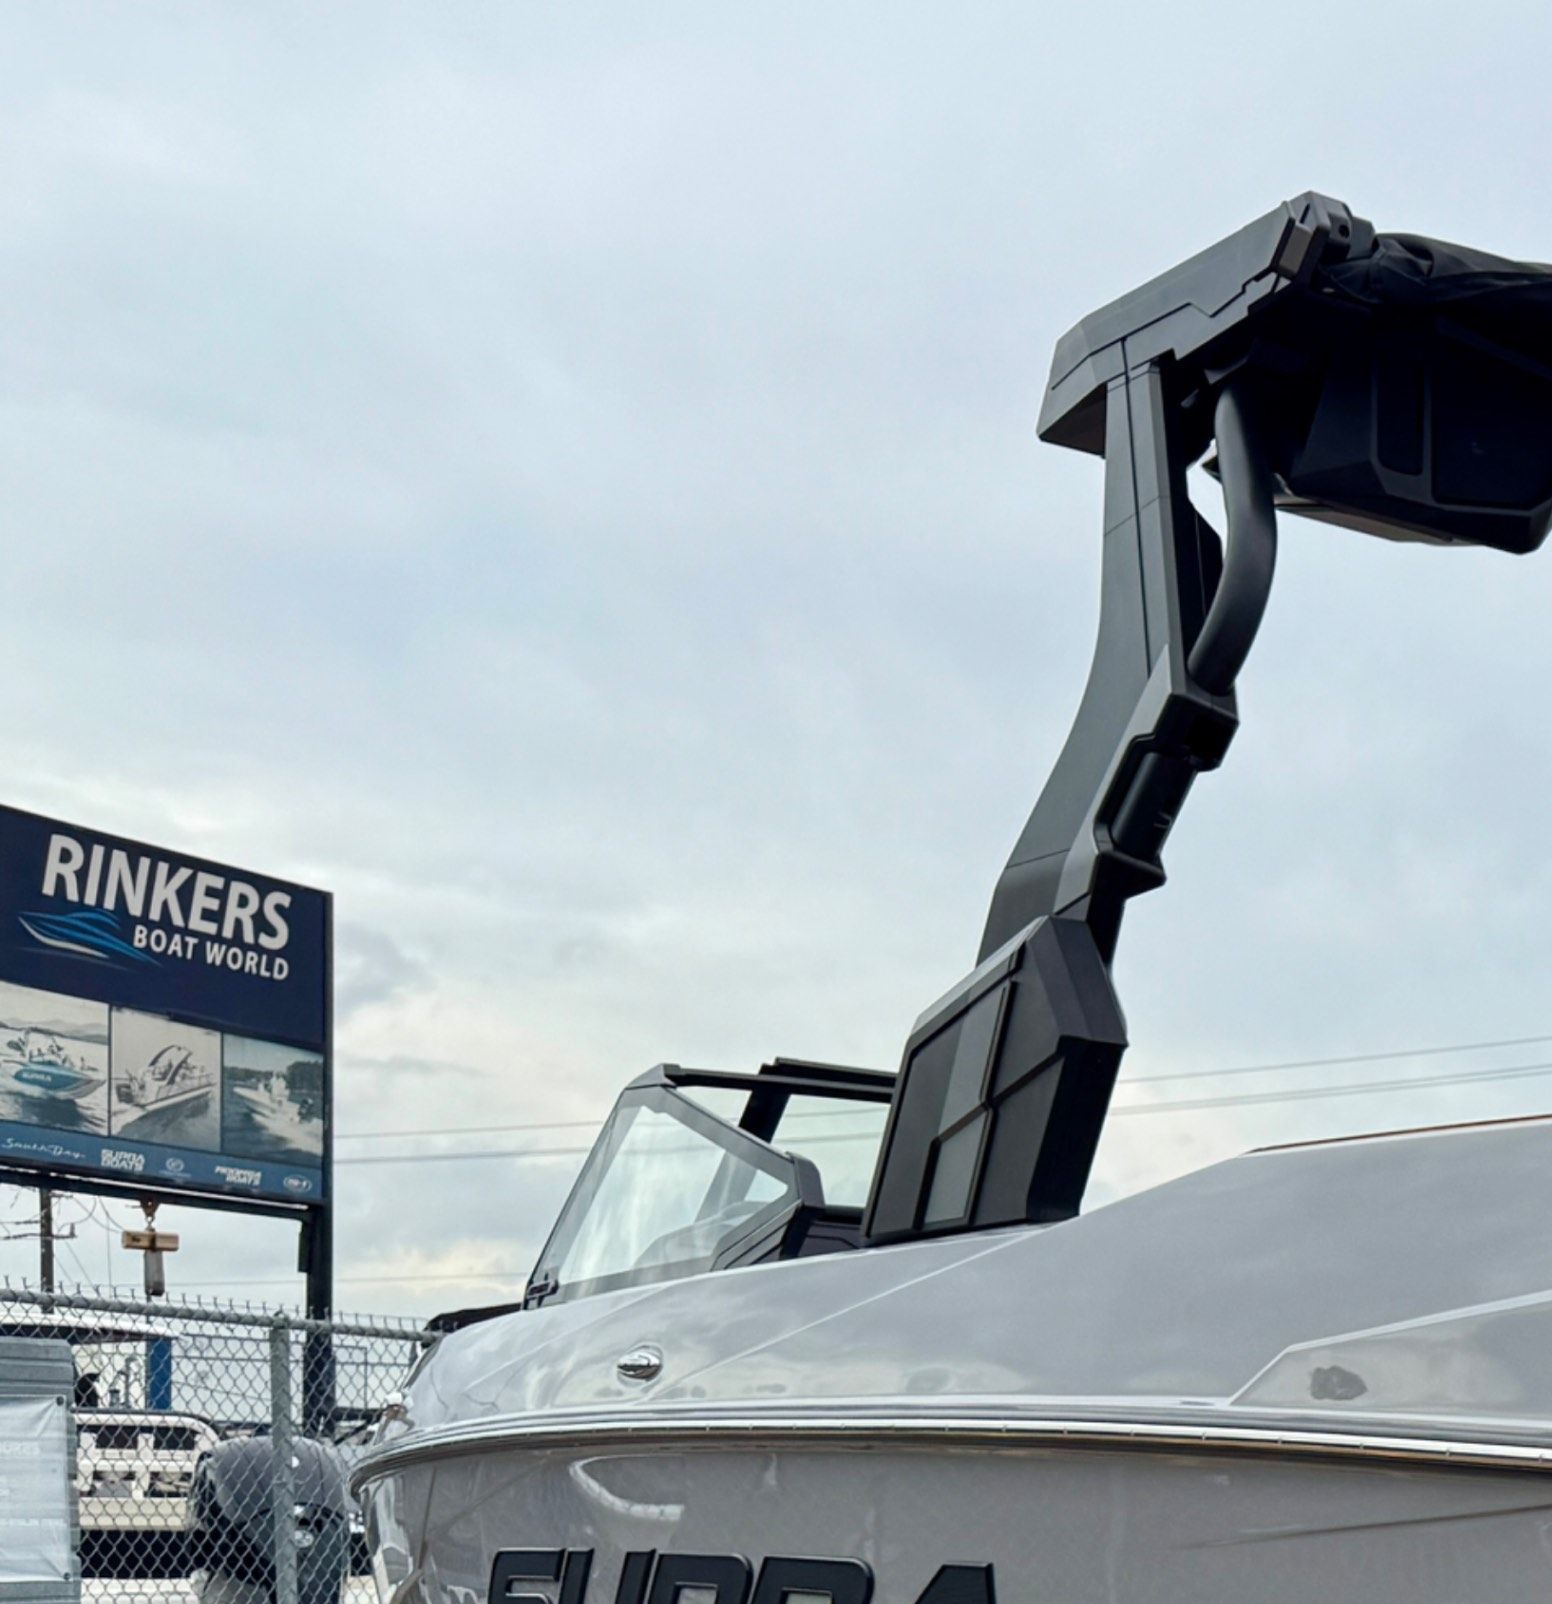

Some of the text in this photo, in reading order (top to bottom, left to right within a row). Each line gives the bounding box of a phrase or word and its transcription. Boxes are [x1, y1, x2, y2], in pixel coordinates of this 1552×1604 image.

[42, 834, 291, 950] RINKERS
[133, 925, 289, 981] BOAT WORLD
